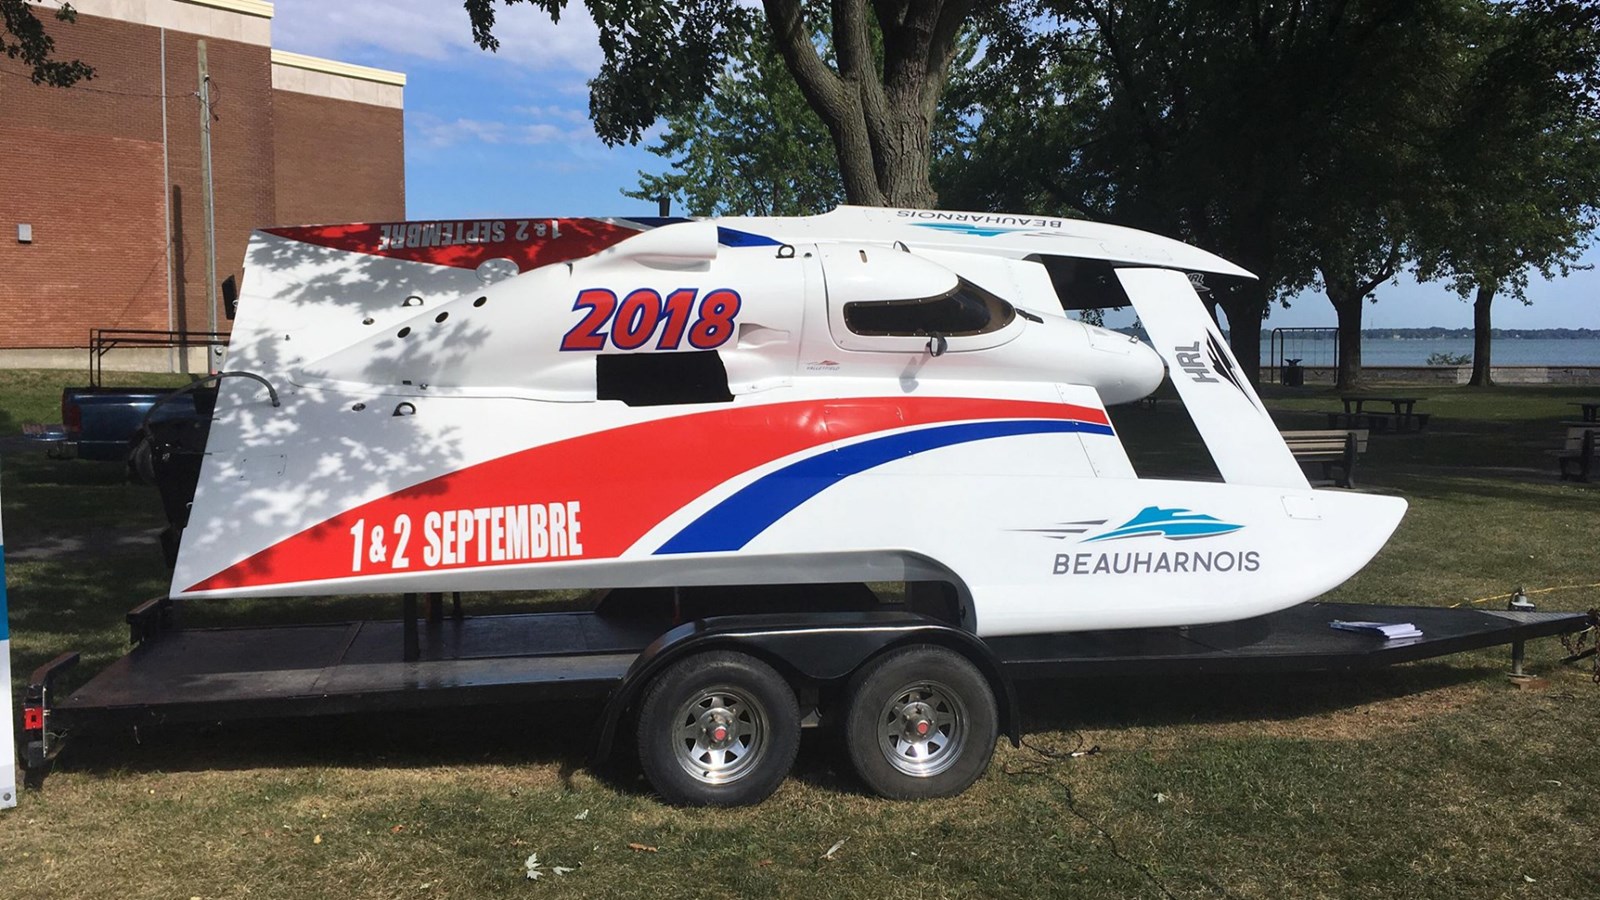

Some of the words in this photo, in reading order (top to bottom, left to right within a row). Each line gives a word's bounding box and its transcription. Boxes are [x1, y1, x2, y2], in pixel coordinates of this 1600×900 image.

[515, 220, 528, 241] 2
[533, 222, 547, 237] &
[551, 219, 562, 239] 1
[896, 209, 1062, 229] BEAUHARNOIS
[377, 220, 506, 251] SEPTEMBRE
[559, 287, 742, 352] 2018
[1174, 340, 1220, 383] HRL
[350, 518, 365, 572] 1
[368, 525, 387, 563] &
[391, 513, 412, 569] 2
[423, 500, 583, 567] SEPTEMBRE
[1052, 550, 1261, 574] BEAUHARNOIS
